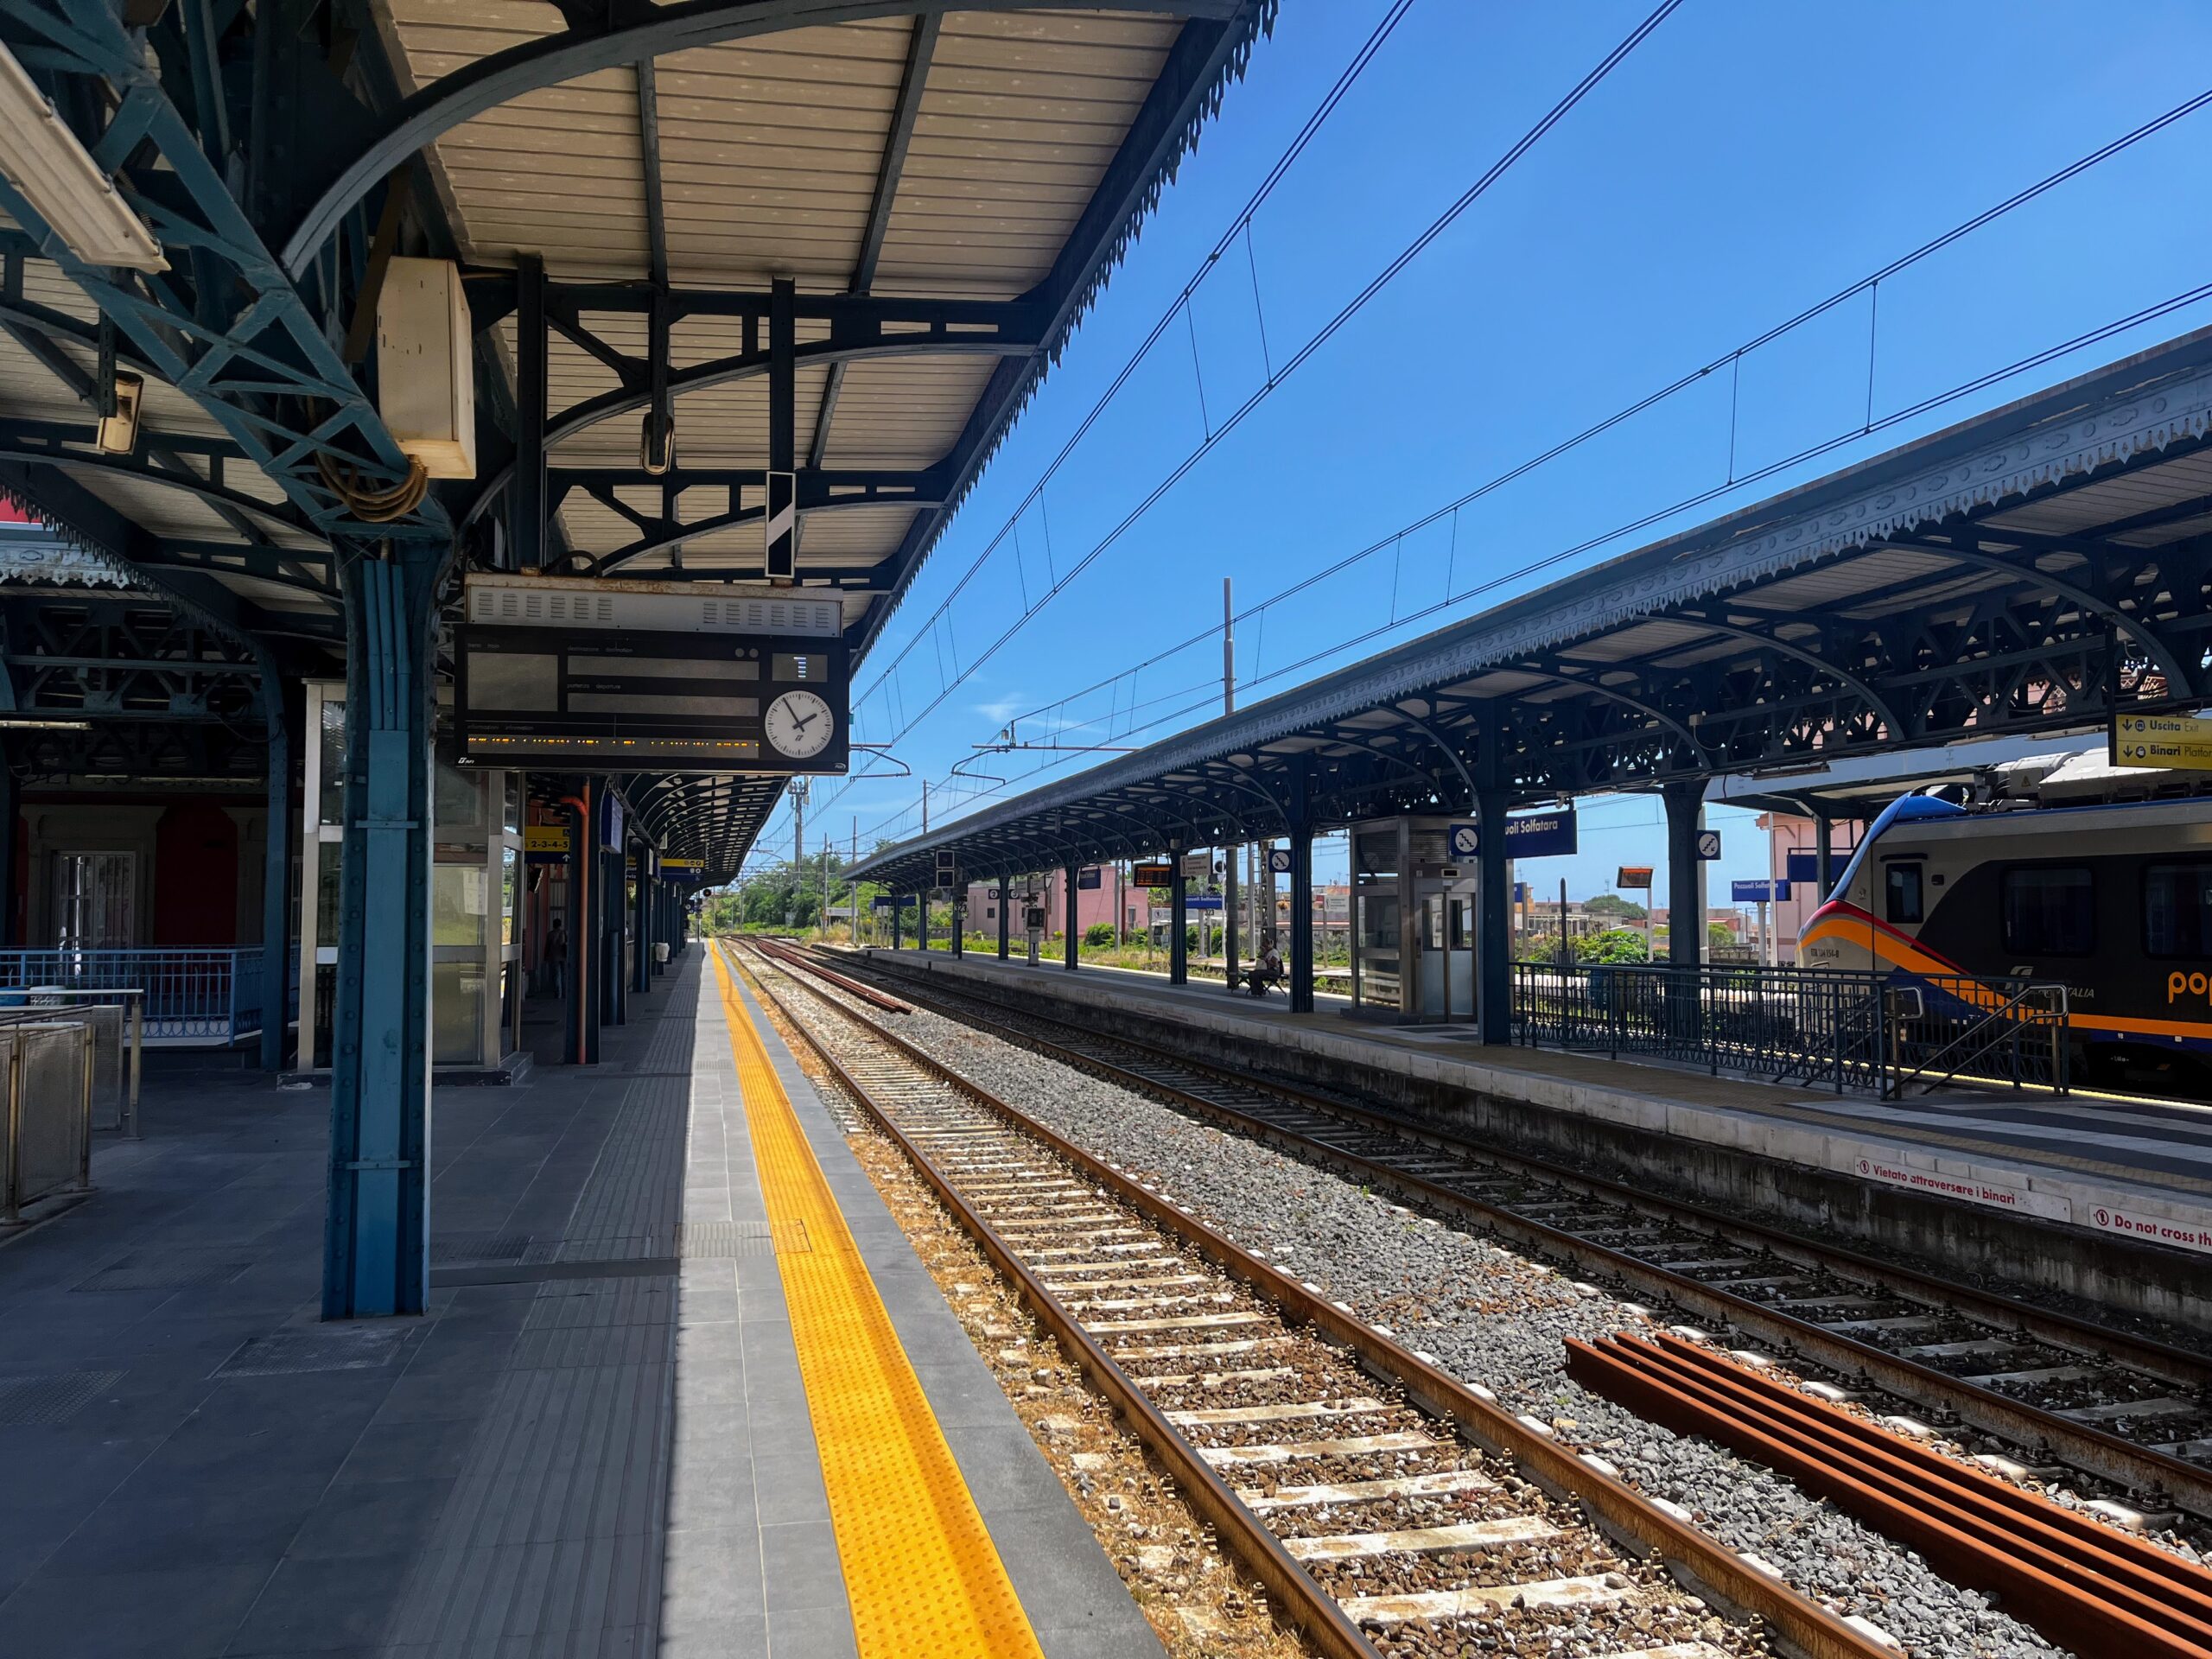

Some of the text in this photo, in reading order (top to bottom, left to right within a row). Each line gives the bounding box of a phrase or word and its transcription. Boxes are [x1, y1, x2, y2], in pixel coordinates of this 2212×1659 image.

[793, 657, 805, 677] 1
[2150, 720, 2199, 732] Uscita Exit
[2151, 745, 2180, 756] Binari
[1504, 818, 1558, 836] uoli Solfatara
[2168, 971, 2212, 1006] po
[1873, 1165, 2015, 1205] Vietato attraversare i binari
[2114, 1215, 2212, 1247] Do not cross th
